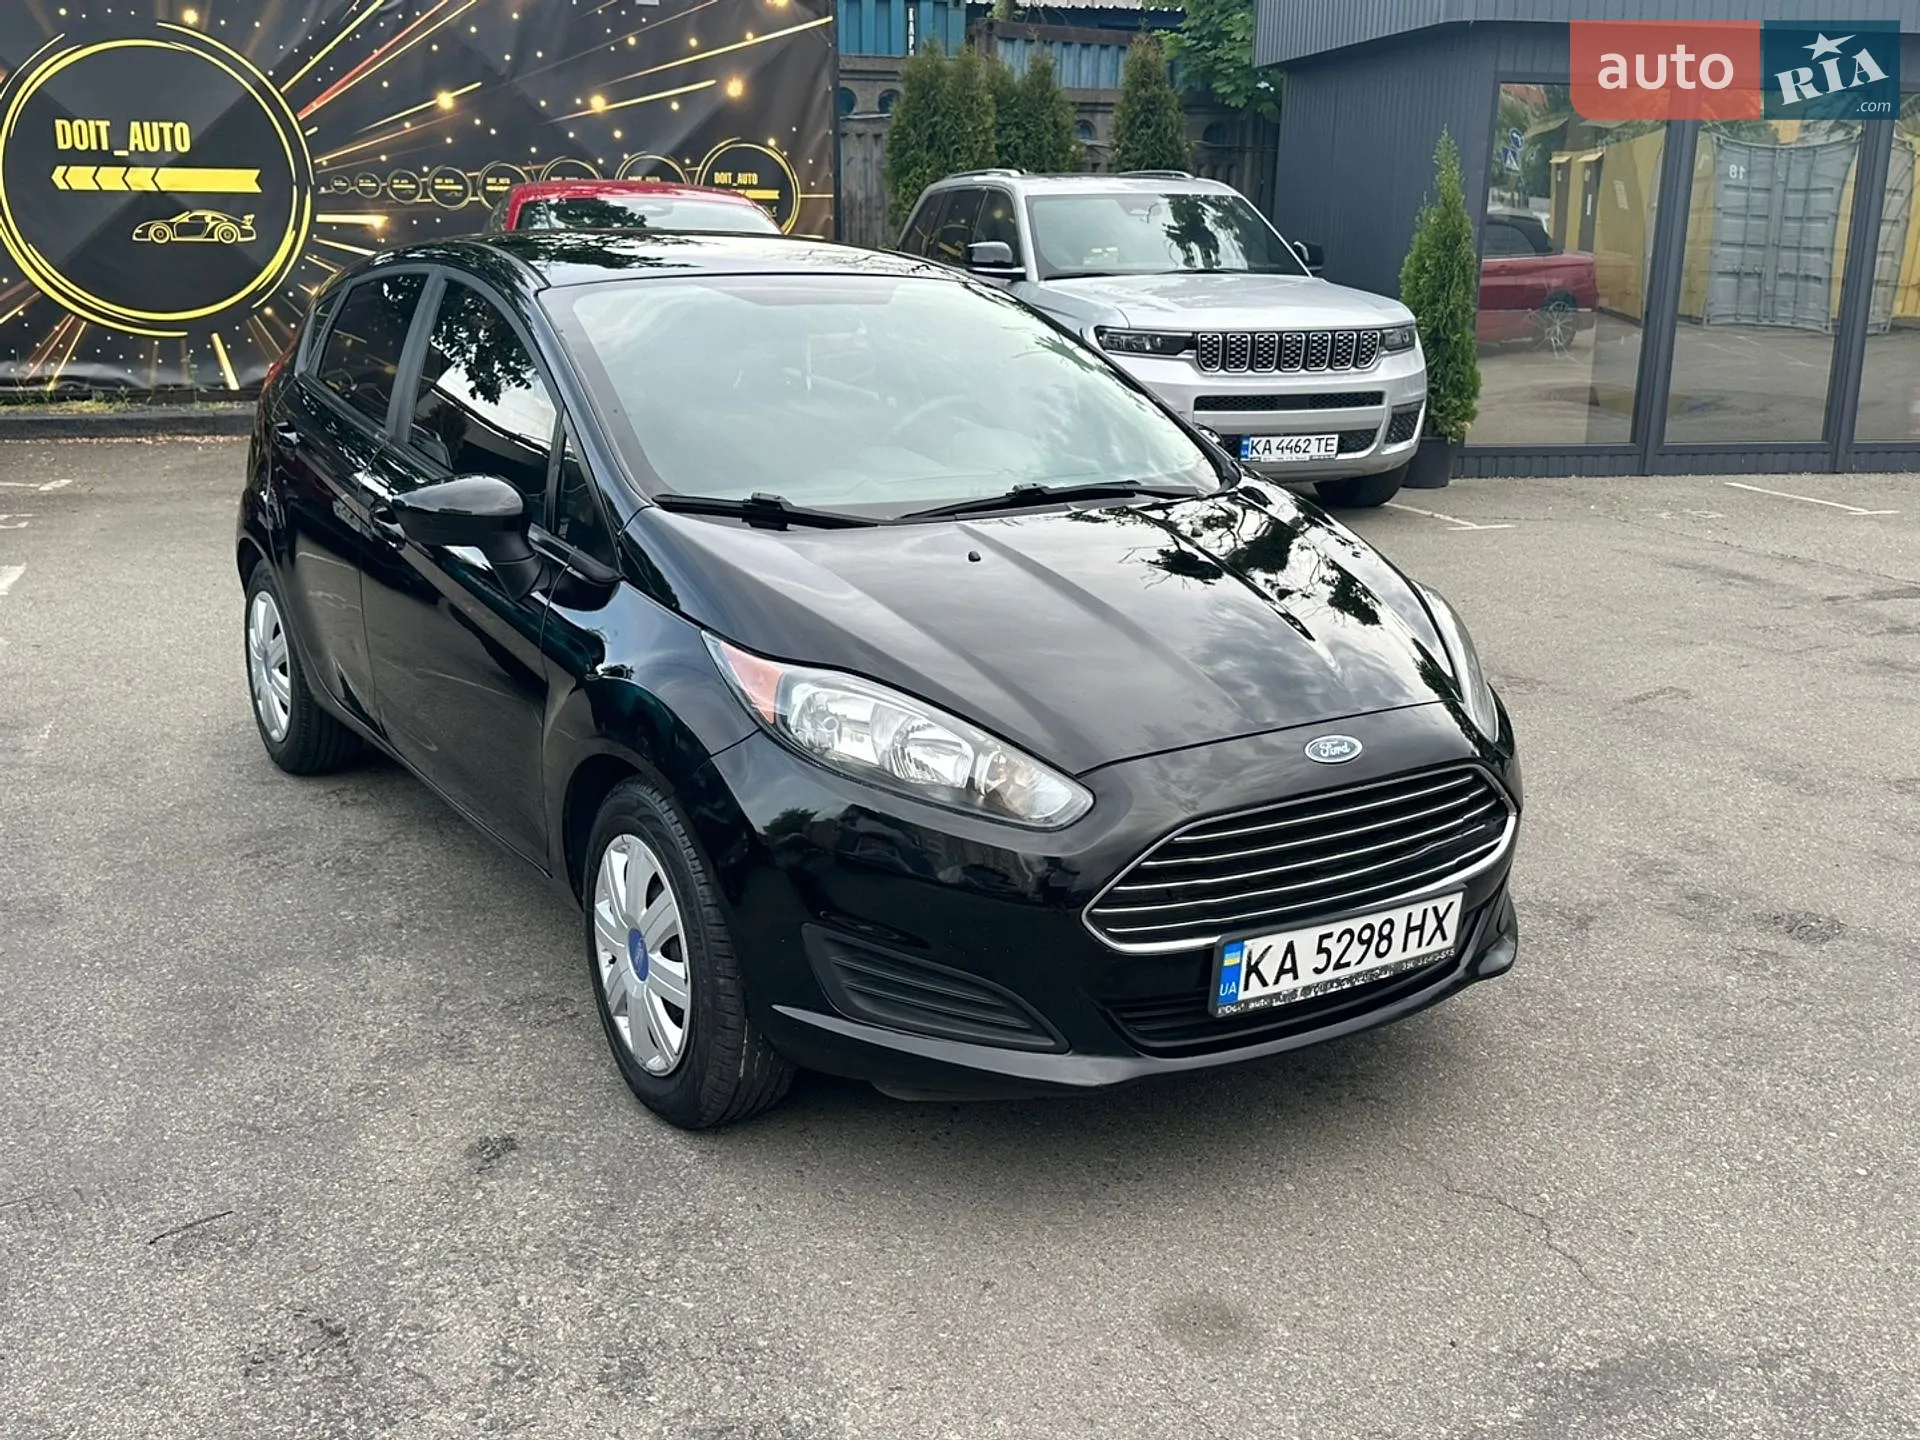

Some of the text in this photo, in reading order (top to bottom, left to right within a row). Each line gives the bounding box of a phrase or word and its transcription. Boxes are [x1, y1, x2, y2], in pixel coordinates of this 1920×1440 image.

[54, 118, 191, 156] DOIT_AUTO
[1250, 439, 1272, 455] KA
[1275, 438, 1312, 455] 4462
[1315, 437, 1336, 453] TE
[1319, 740, 1351, 757] Ford
[1243, 940, 1299, 992] KA
[1312, 917, 1395, 975] 5298
[1401, 901, 1455, 953] HX
[1219, 981, 1237, 996] UA
